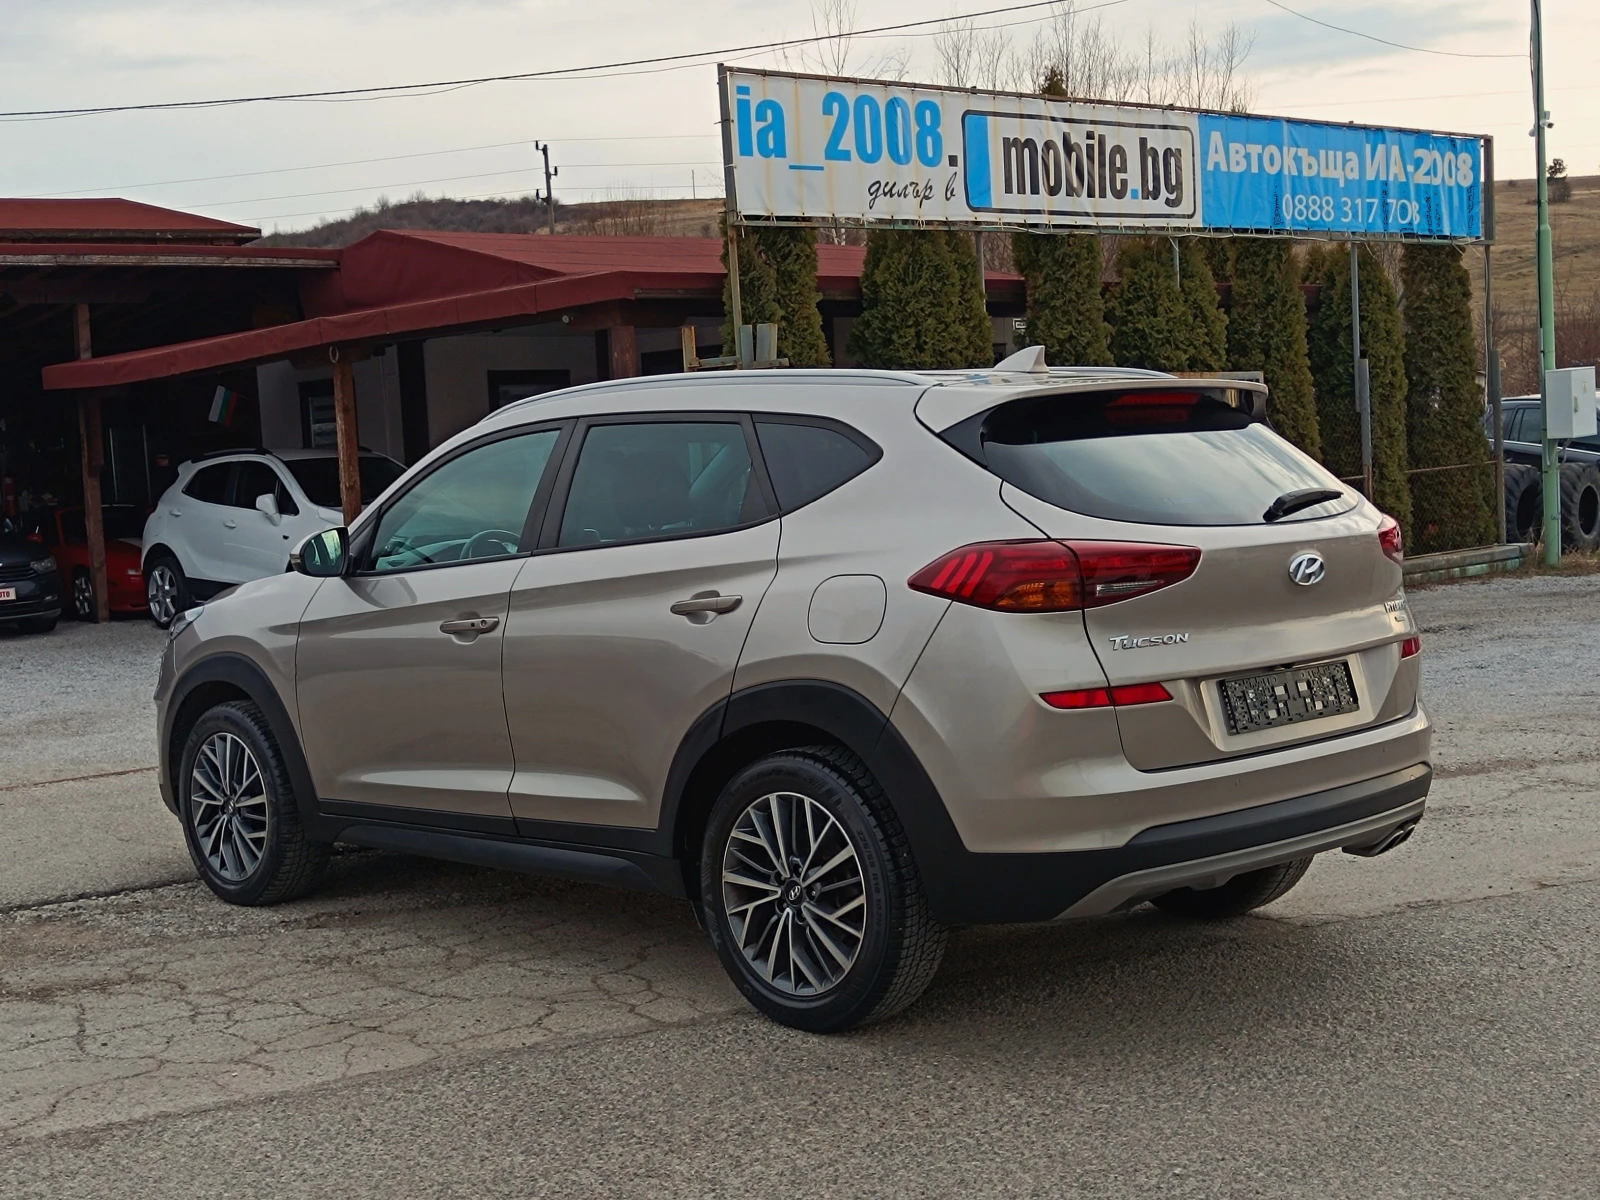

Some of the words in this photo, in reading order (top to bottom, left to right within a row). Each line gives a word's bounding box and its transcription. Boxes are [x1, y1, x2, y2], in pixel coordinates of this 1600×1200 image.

[1002, 130, 1184, 208] mobile.bg
[867, 178, 936, 210] дилър
[944, 171, 958, 202] в
[1282, 193, 1335, 221] 0888
[1341, 197, 1378, 223] 317
[1387, 199, 1420, 225] 708
[1108, 632, 1189, 651] TUCSON
